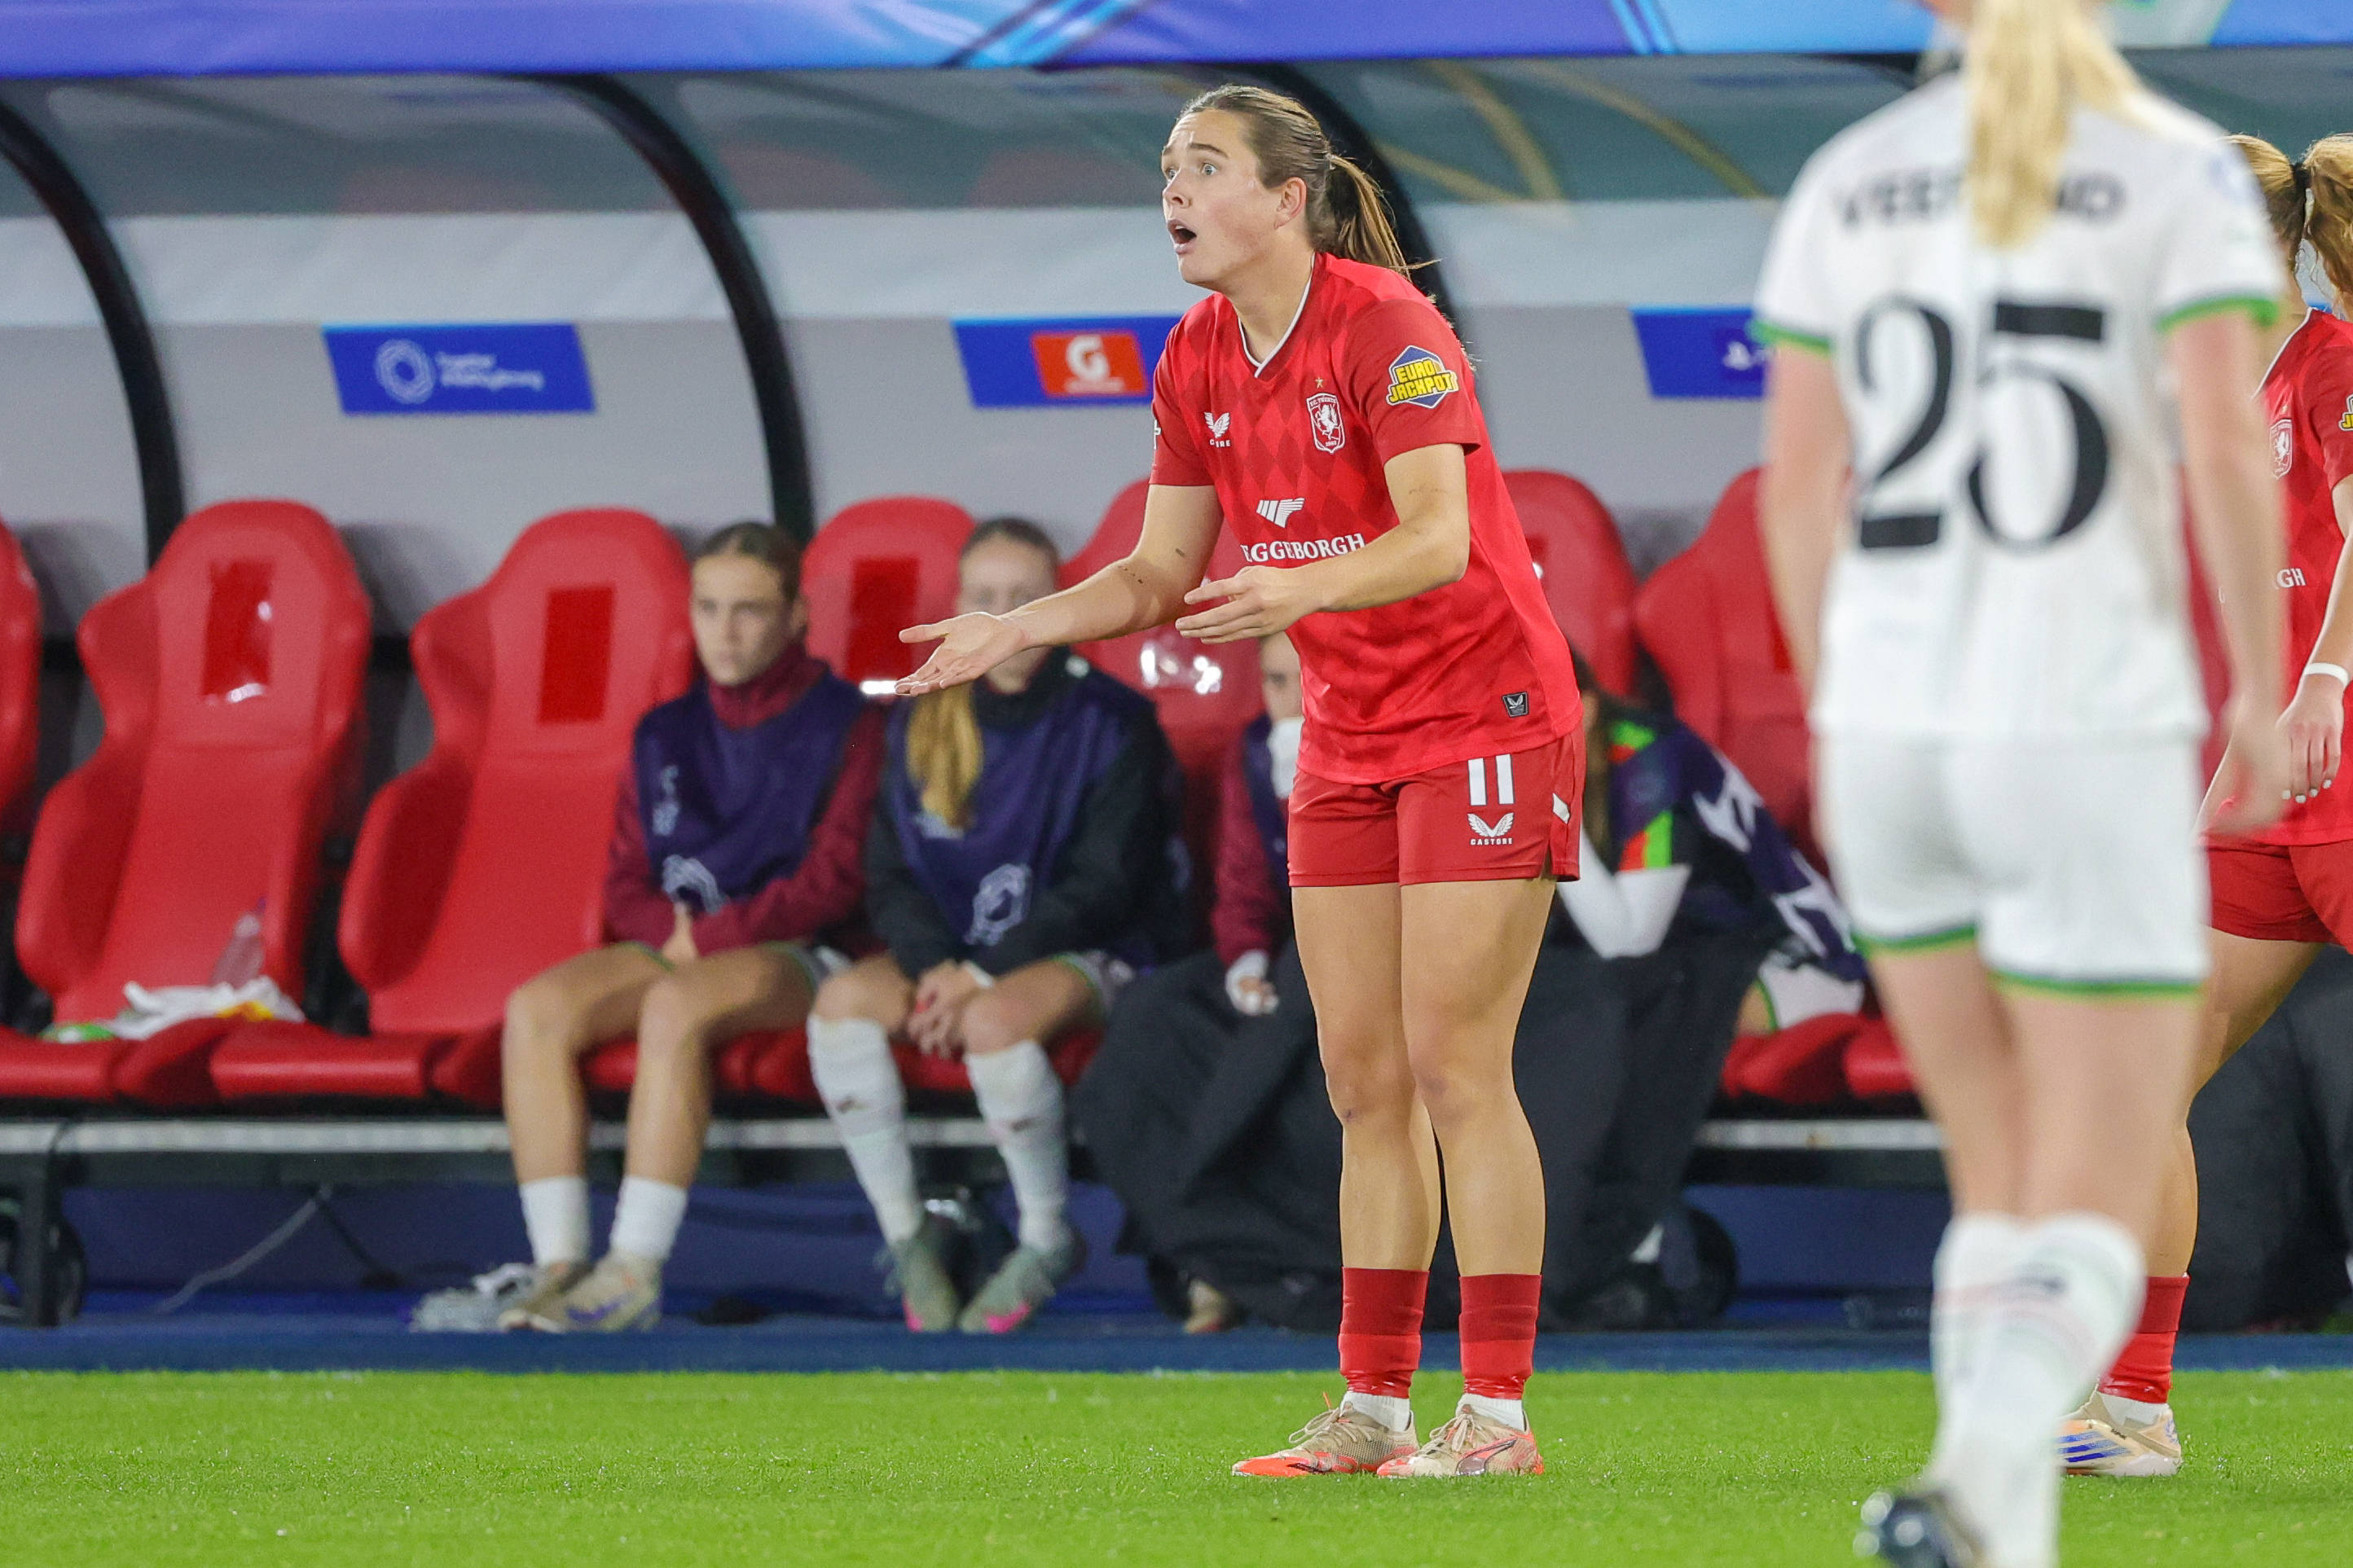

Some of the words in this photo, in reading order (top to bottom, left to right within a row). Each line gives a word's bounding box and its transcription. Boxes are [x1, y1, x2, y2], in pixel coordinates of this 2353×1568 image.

[1066, 334, 1111, 381] G
[1395, 359, 1436, 384] EURO
[1389, 373, 1454, 403] JACKPOT
[1854, 295, 2109, 551] 25
[1240, 533, 1366, 563] EGGEBORGH
[1467, 753, 1515, 806] 11
